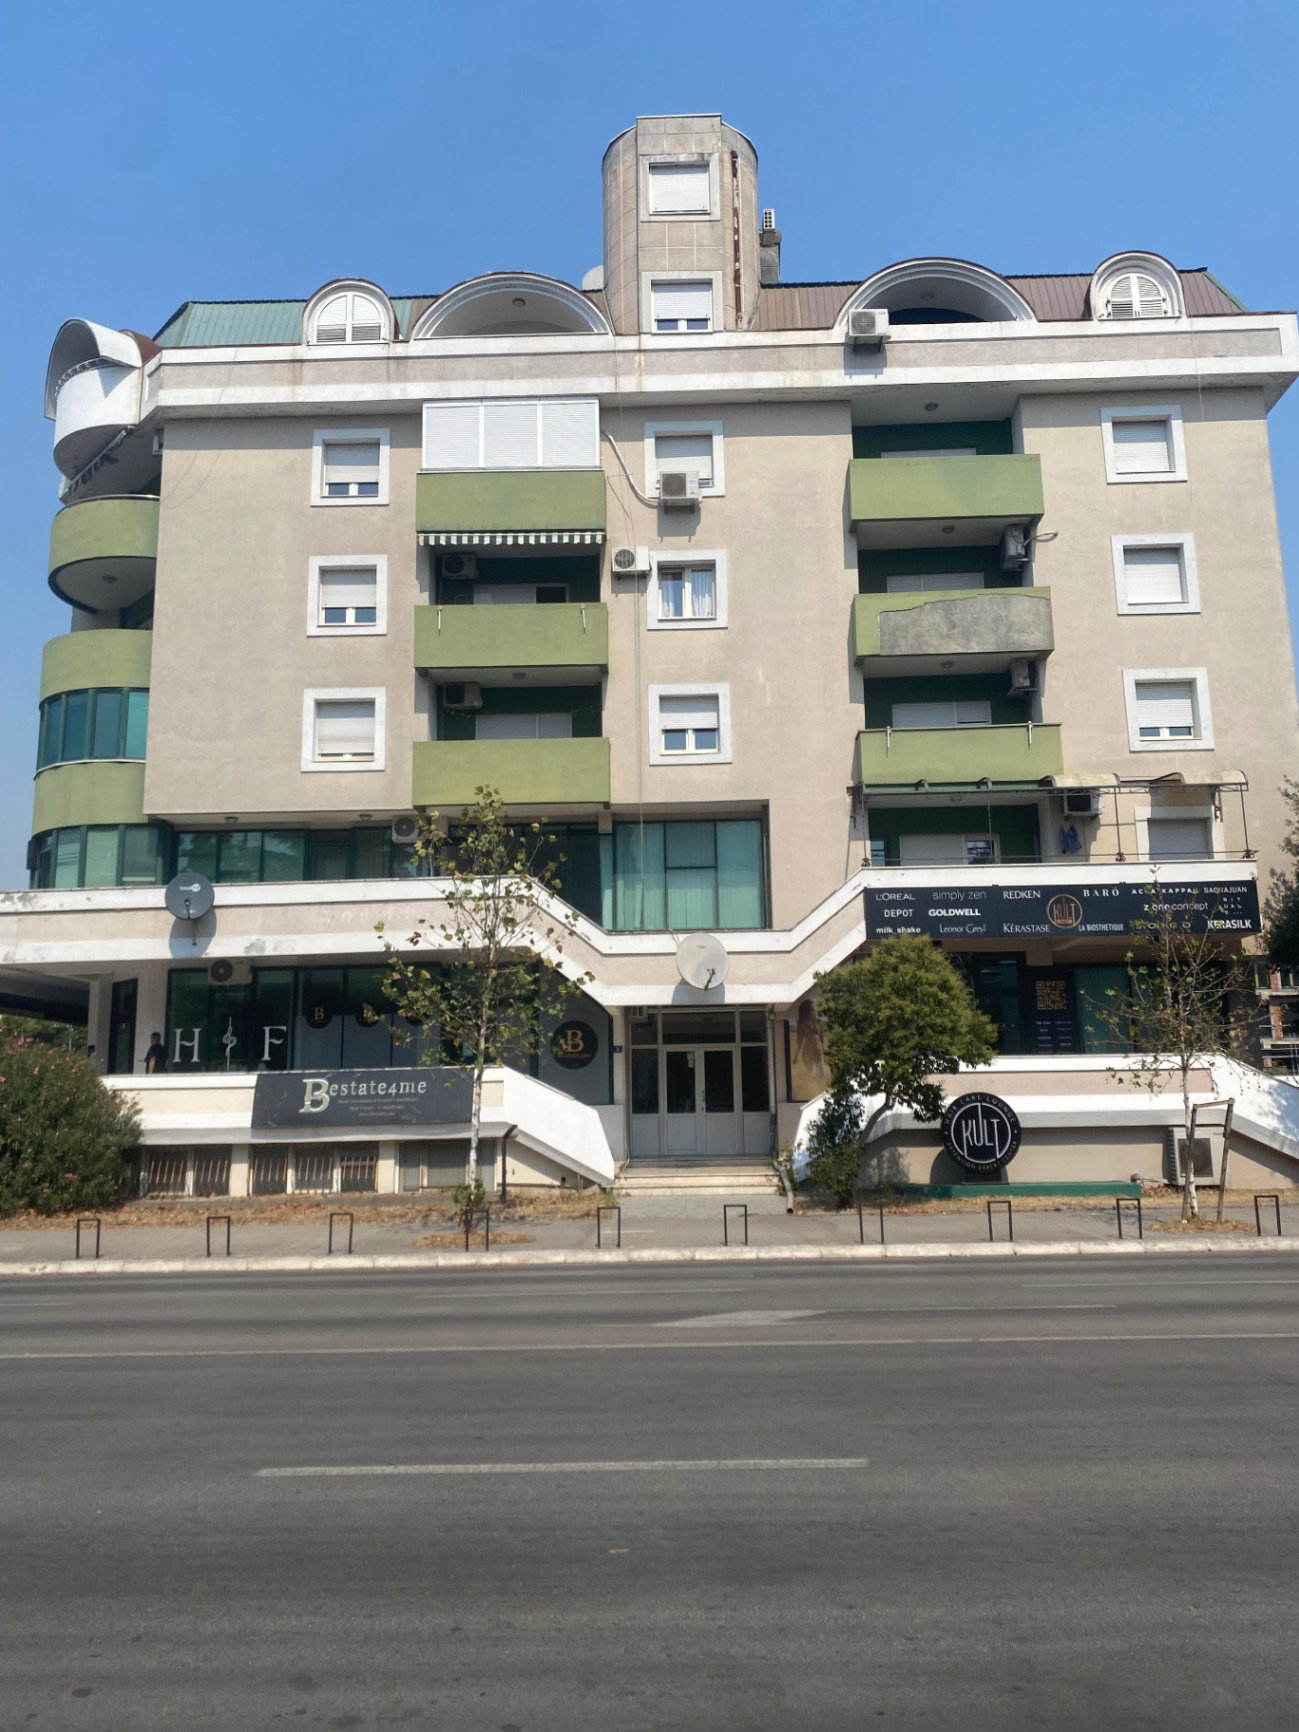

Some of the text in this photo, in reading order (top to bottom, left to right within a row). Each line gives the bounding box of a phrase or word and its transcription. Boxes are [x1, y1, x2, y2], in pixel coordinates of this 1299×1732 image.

[933, 890, 986, 901] simply zen
[1003, 890, 1041, 899] REDKEN
[1083, 887, 1120, 897] BARÓ
[928, 908, 981, 916] GOLDWELL
[1172, 902, 1209, 913] concept
[884, 909, 914, 918] DEPOT
[940, 924, 963, 933] Leonor
[1003, 922, 1050, 933] KÉRASTASE
[1207, 920, 1252, 929] KERASILK
[876, 926, 921, 934] milk_shake
[172, 1026, 287, 1062] H F
[987, 1096, 1016, 1124] LOUNGE
[962, 1103, 1000, 1158] KULT
